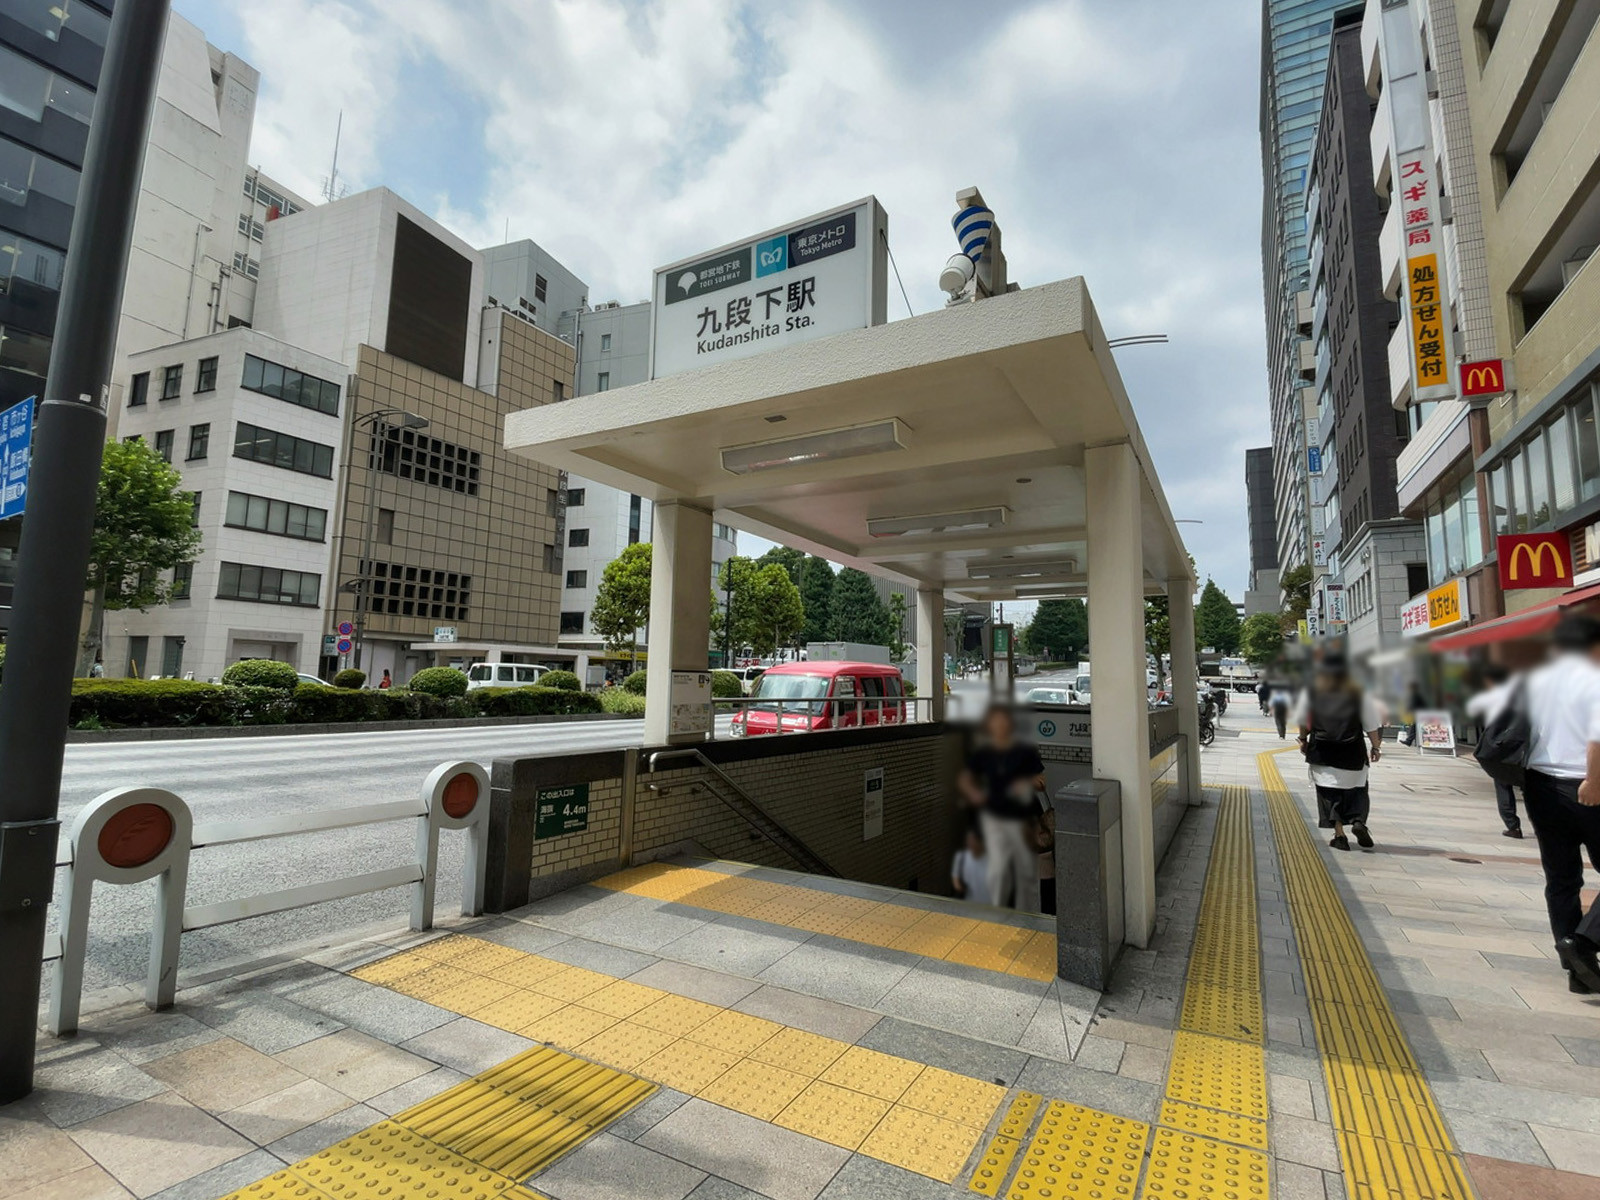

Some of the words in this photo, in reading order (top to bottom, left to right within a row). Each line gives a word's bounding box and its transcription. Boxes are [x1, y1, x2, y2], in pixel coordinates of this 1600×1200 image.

[1401, 160, 1431, 247] スギ薬局
[797, 224, 846, 250] 東京メトロ
[800, 245, 820, 257] Tokyo
[821, 238, 843, 251] Metro
[699, 258, 741, 280] 都営地下鉄
[699, 277, 714, 289] TOEI
[714, 270, 741, 286] SUBWAY
[696, 276, 816, 338] 九段下駅
[696, 323, 780, 355] Kudanshita
[785, 313, 816, 332] Sta.
[1412, 265, 1443, 378] 処方せん受付
[1402, 603, 1428, 631] スギ薬局
[562, 803, 587, 816] 4.4m
